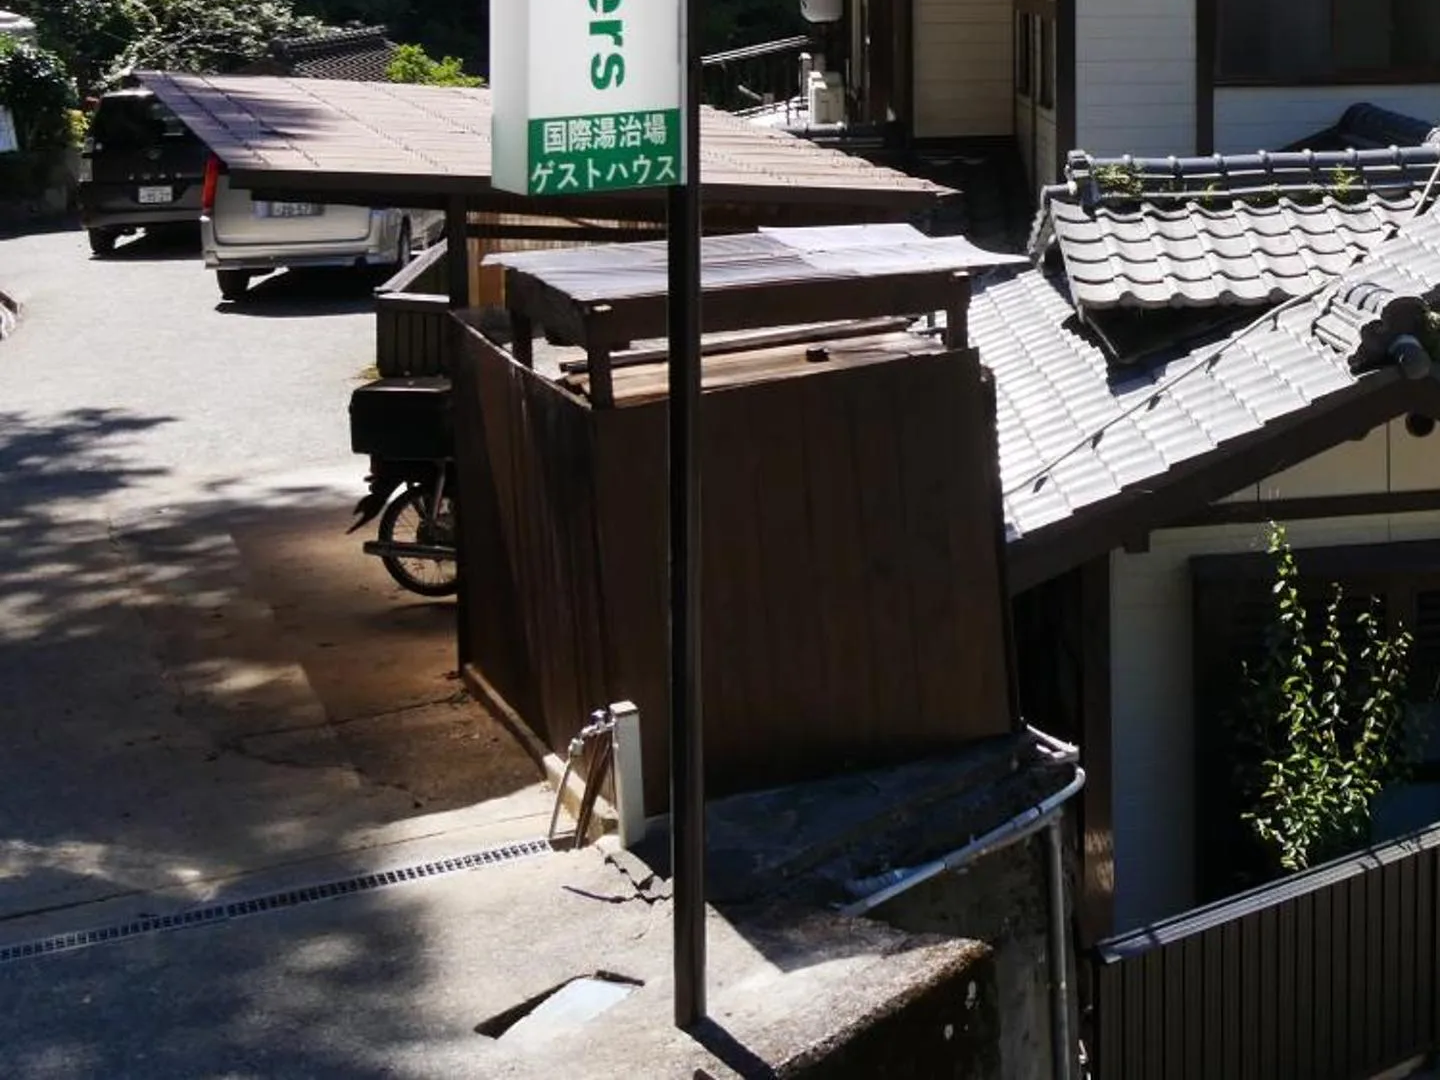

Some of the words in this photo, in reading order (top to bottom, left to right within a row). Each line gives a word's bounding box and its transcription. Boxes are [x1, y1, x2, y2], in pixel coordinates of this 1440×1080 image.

[542, 113, 668, 154] 国際湯治場
[530, 154, 677, 194] ゲストハウス
